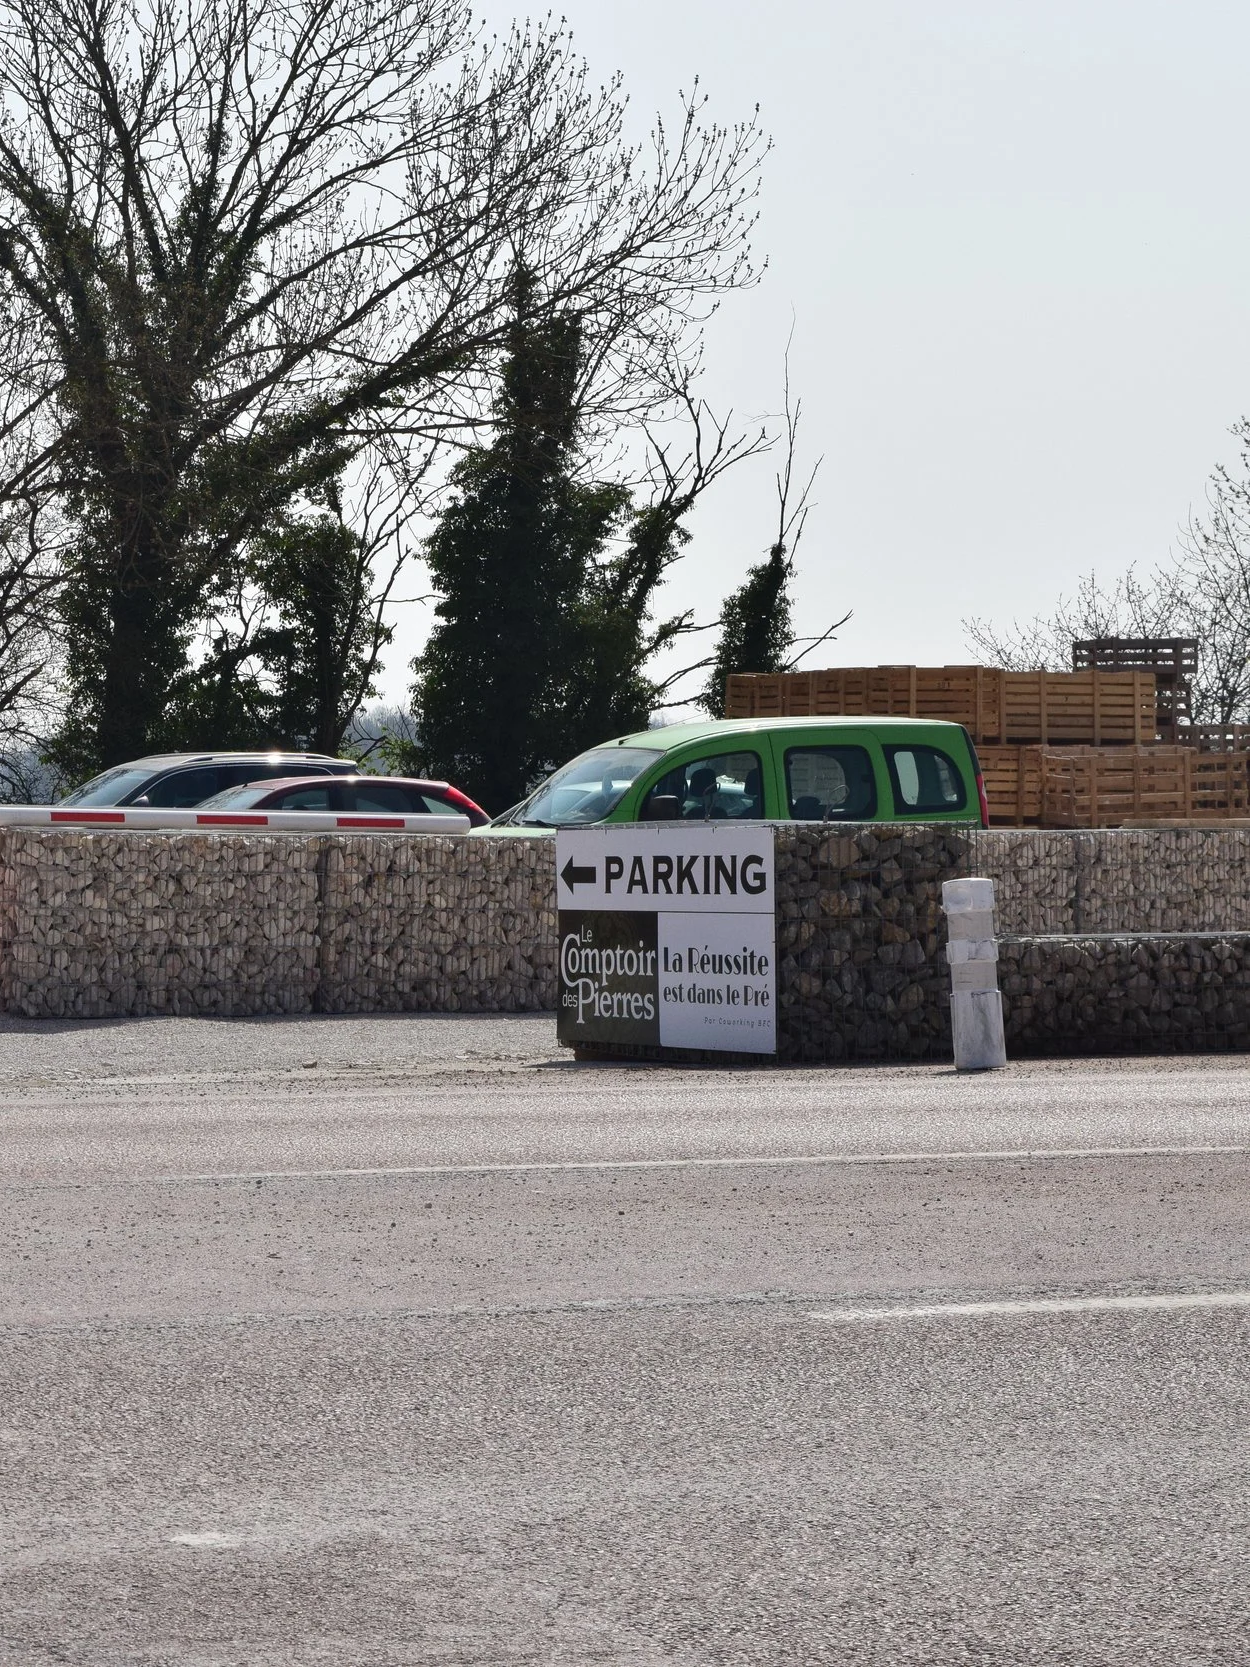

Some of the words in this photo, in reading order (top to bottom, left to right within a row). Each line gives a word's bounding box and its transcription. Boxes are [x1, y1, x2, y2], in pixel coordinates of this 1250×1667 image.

[604, 854, 767, 895] PARKING
[581, 924, 592, 943] Le
[560, 933, 656, 987] Comptoir
[663, 947, 683, 973] La
[688, 945, 769, 976] Réussite
[562, 989, 578, 1008] des
[576, 978, 655, 1024] Pierres
[663, 983, 685, 1003] est
[687, 983, 723, 1005] dans
[726, 984, 740, 1006] le
[743, 983, 770, 1007] Pré
